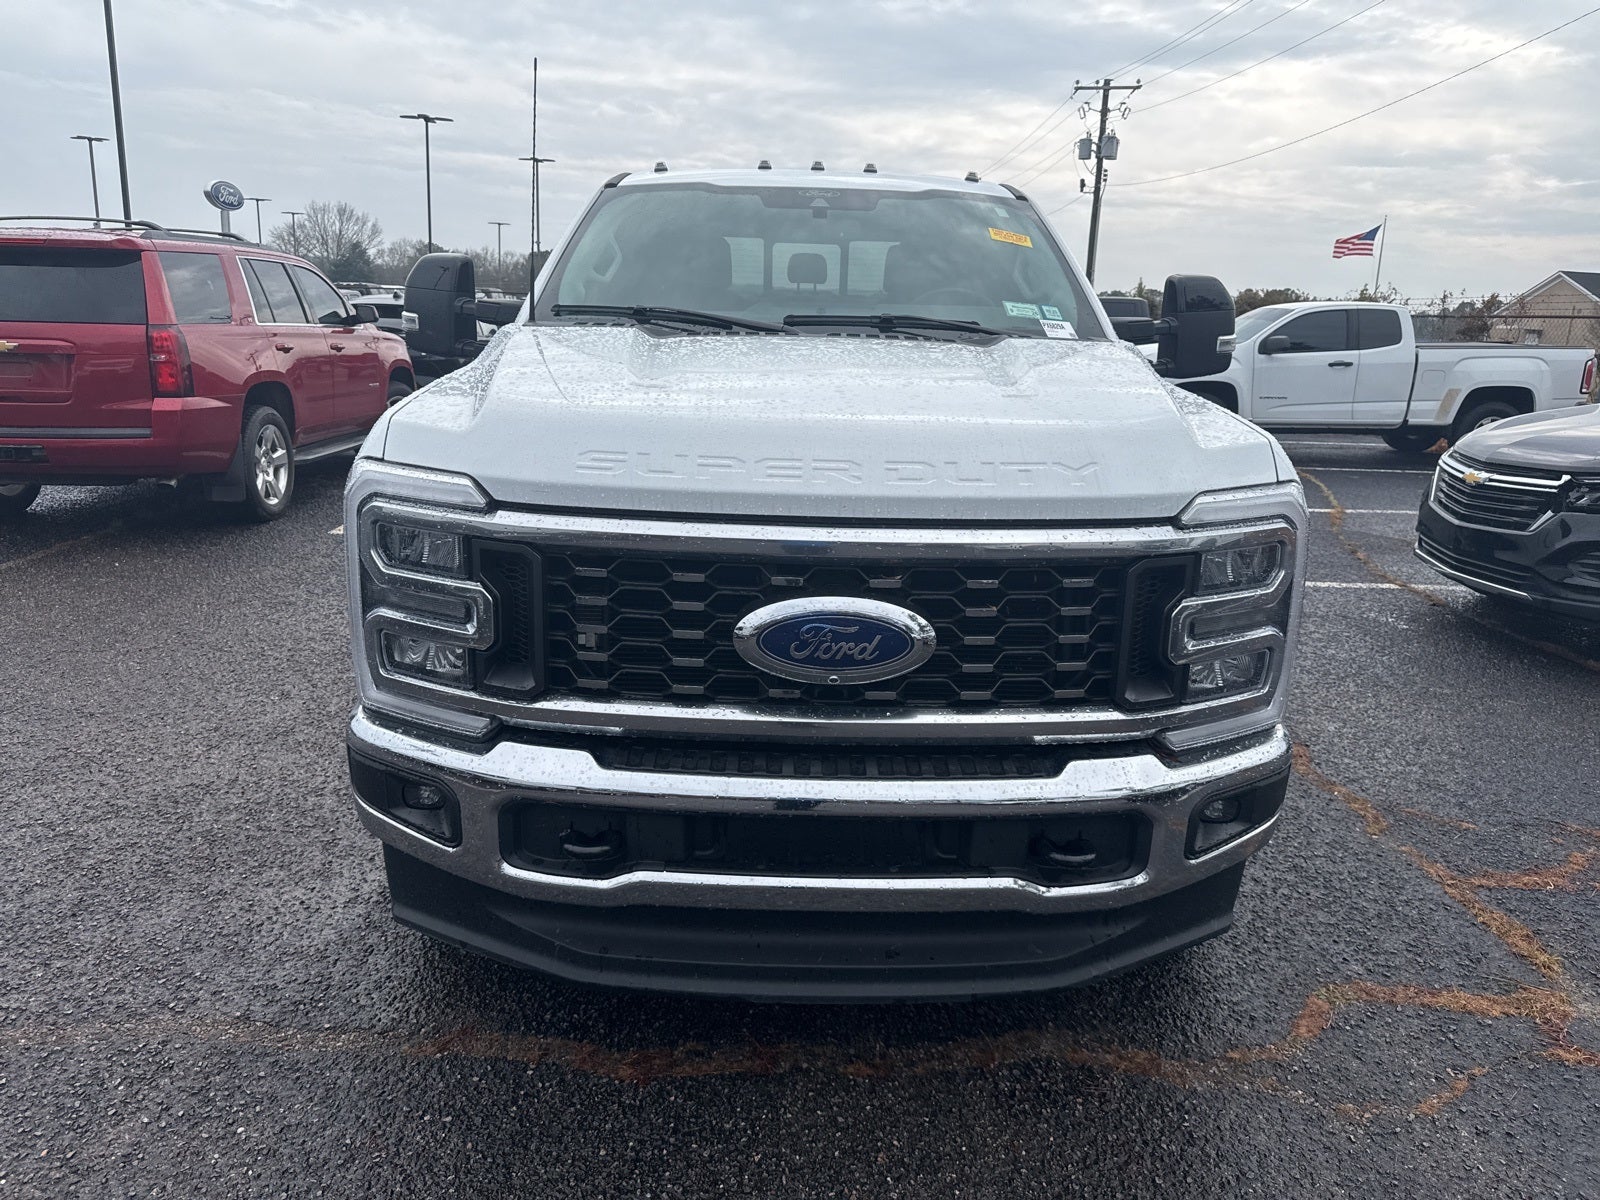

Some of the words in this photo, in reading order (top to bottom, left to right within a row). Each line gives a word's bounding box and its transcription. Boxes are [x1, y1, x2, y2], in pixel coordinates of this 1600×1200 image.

[219, 185, 239, 206] Ford
[575, 449, 862, 484] SUPER
[883, 460, 1099, 486] DUTY
[789, 622, 883, 661] Ford
